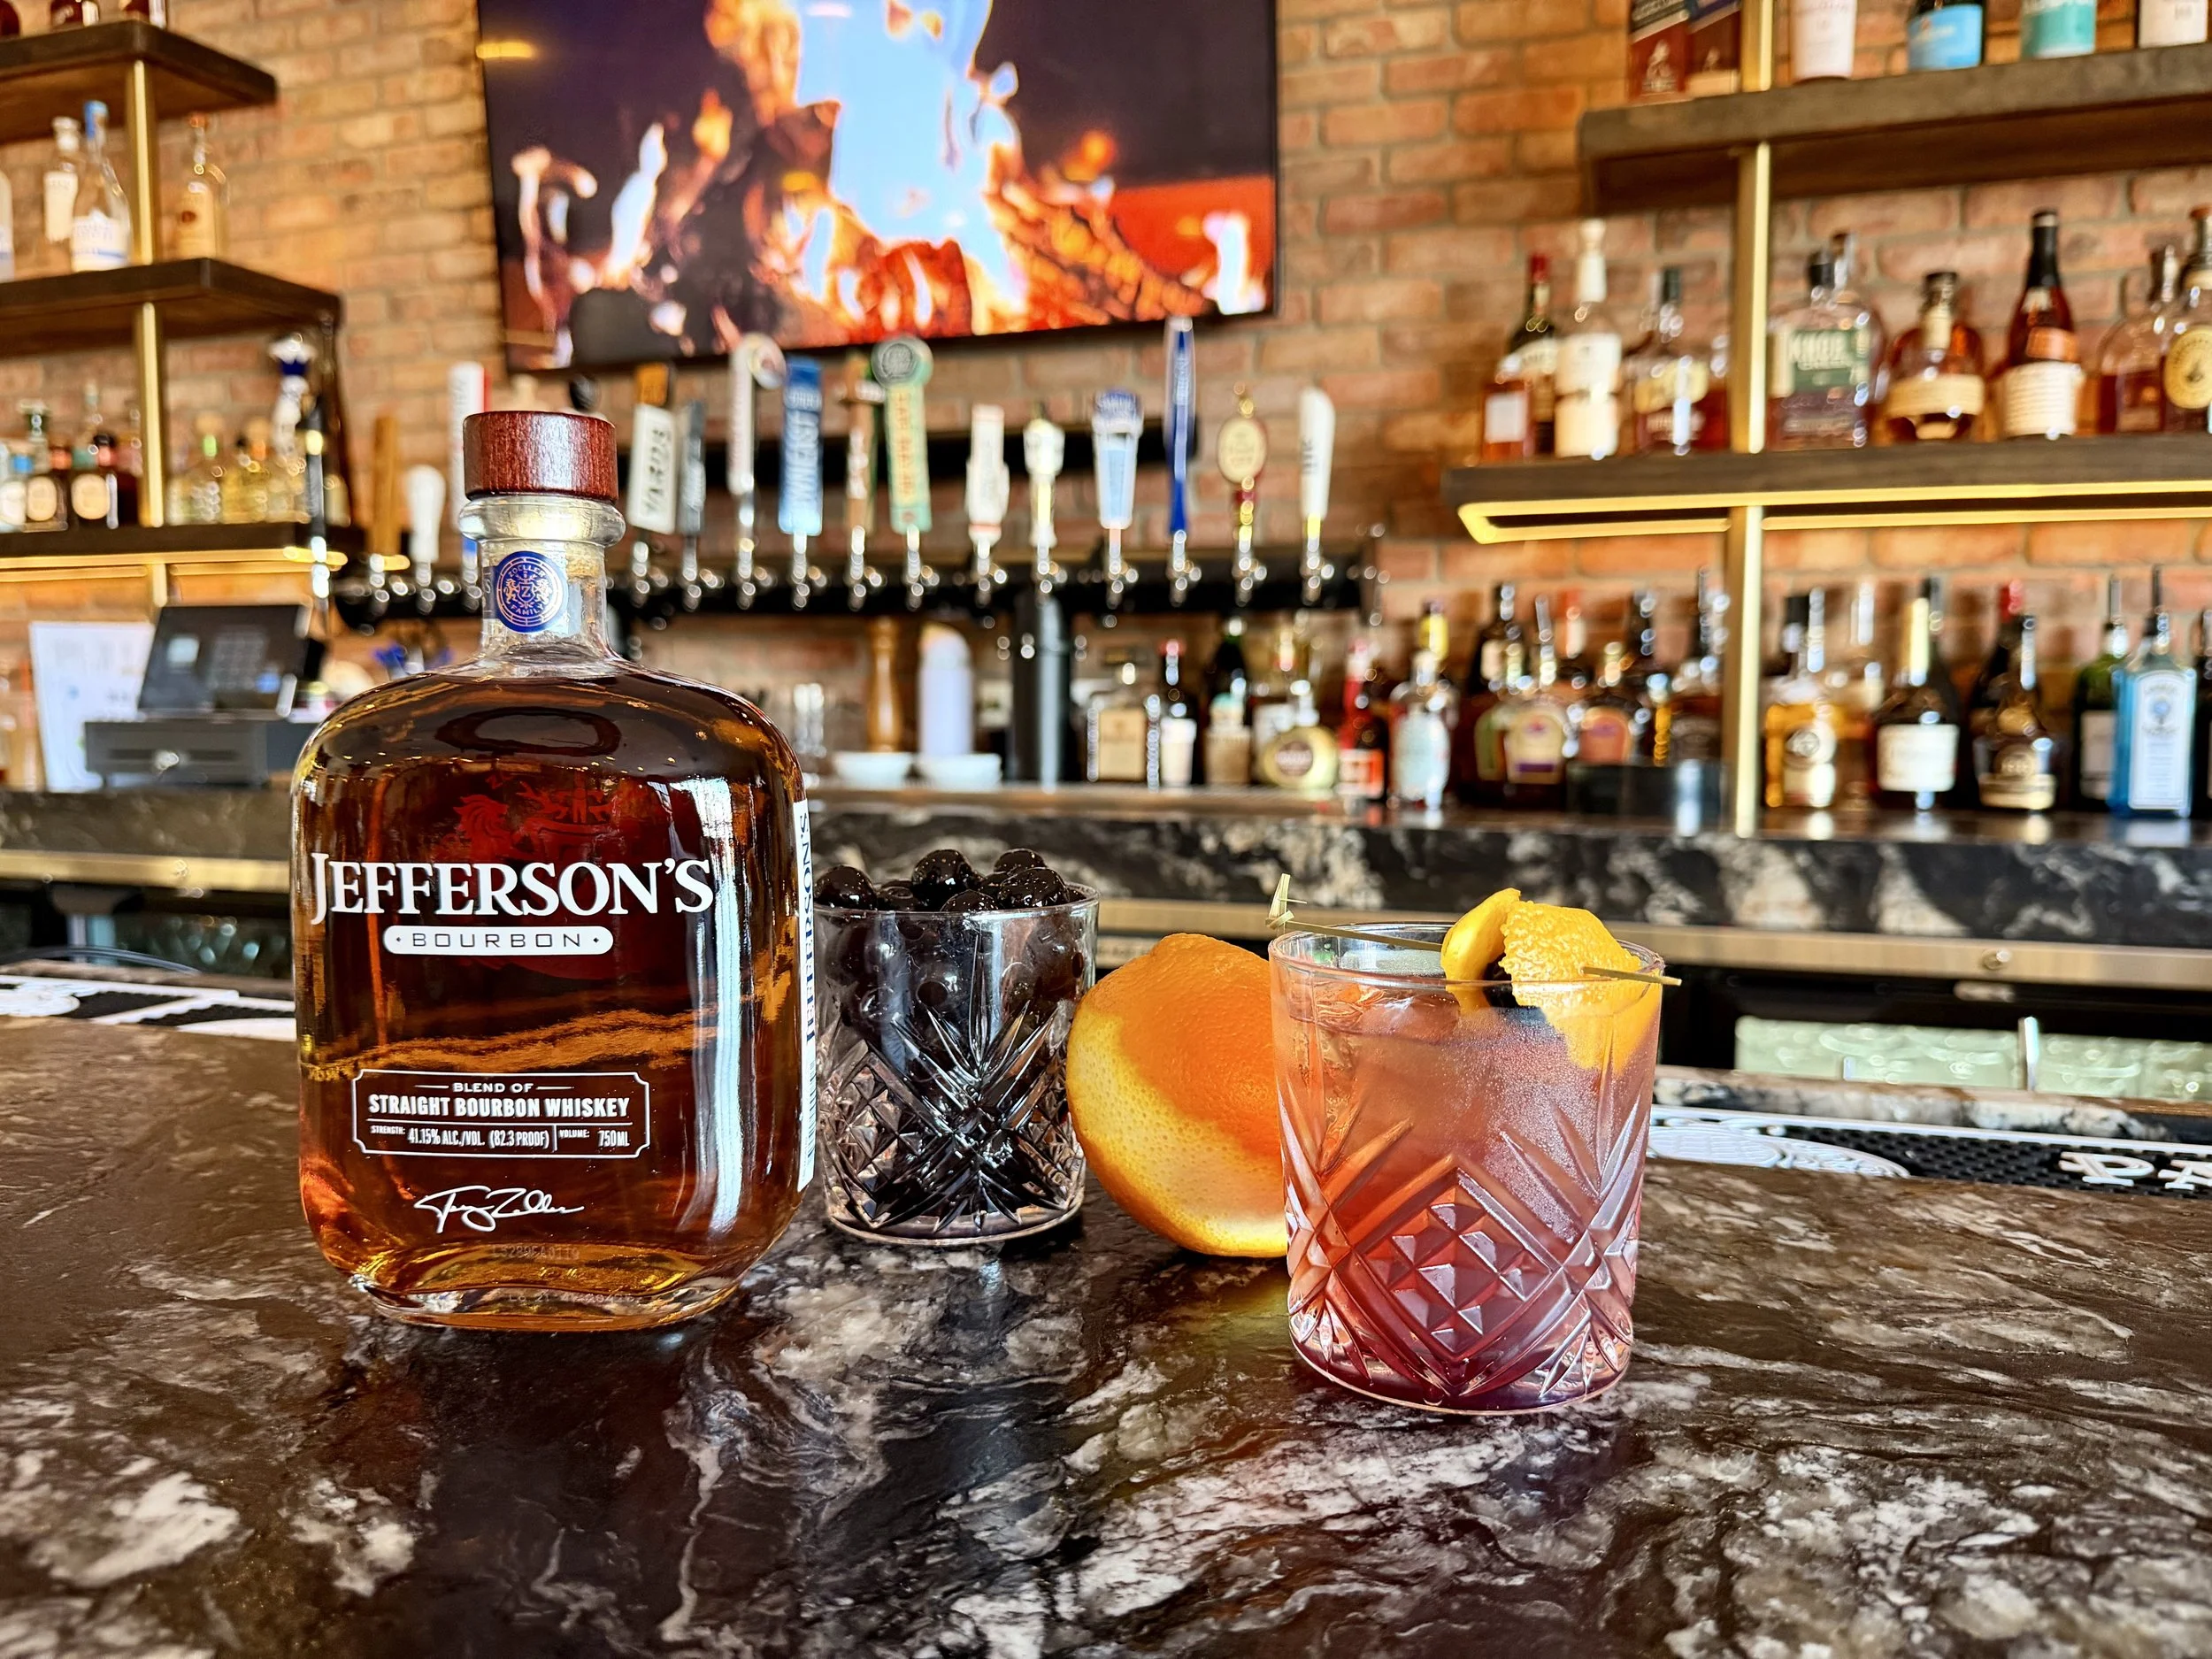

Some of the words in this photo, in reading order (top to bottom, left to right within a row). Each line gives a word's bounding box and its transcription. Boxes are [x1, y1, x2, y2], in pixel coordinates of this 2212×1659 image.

[521, 586, 531, 597] Z
[511, 603, 544, 615] FAMILY
[311, 852, 714, 925] JEFFERSON'S
[412, 933, 580, 948] BOURBON
[453, 1082, 505, 1093] BLEND
[511, 1082, 534, 1093] OF
[368, 1094, 450, 1116] STRAIGHT
[455, 1097, 541, 1118] BOURBON
[544, 1097, 630, 1118] WHISKEY
[371, 1125, 406, 1135] STRENGTH:
[408, 1127, 442, 1145] 41.15%
[442, 1130, 486, 1147] ALC./VOL.
[488, 1130, 515, 1148] (82.3
[516, 1130, 549, 1149] PROOF)
[559, 1129, 590, 1139] VOLUME:
